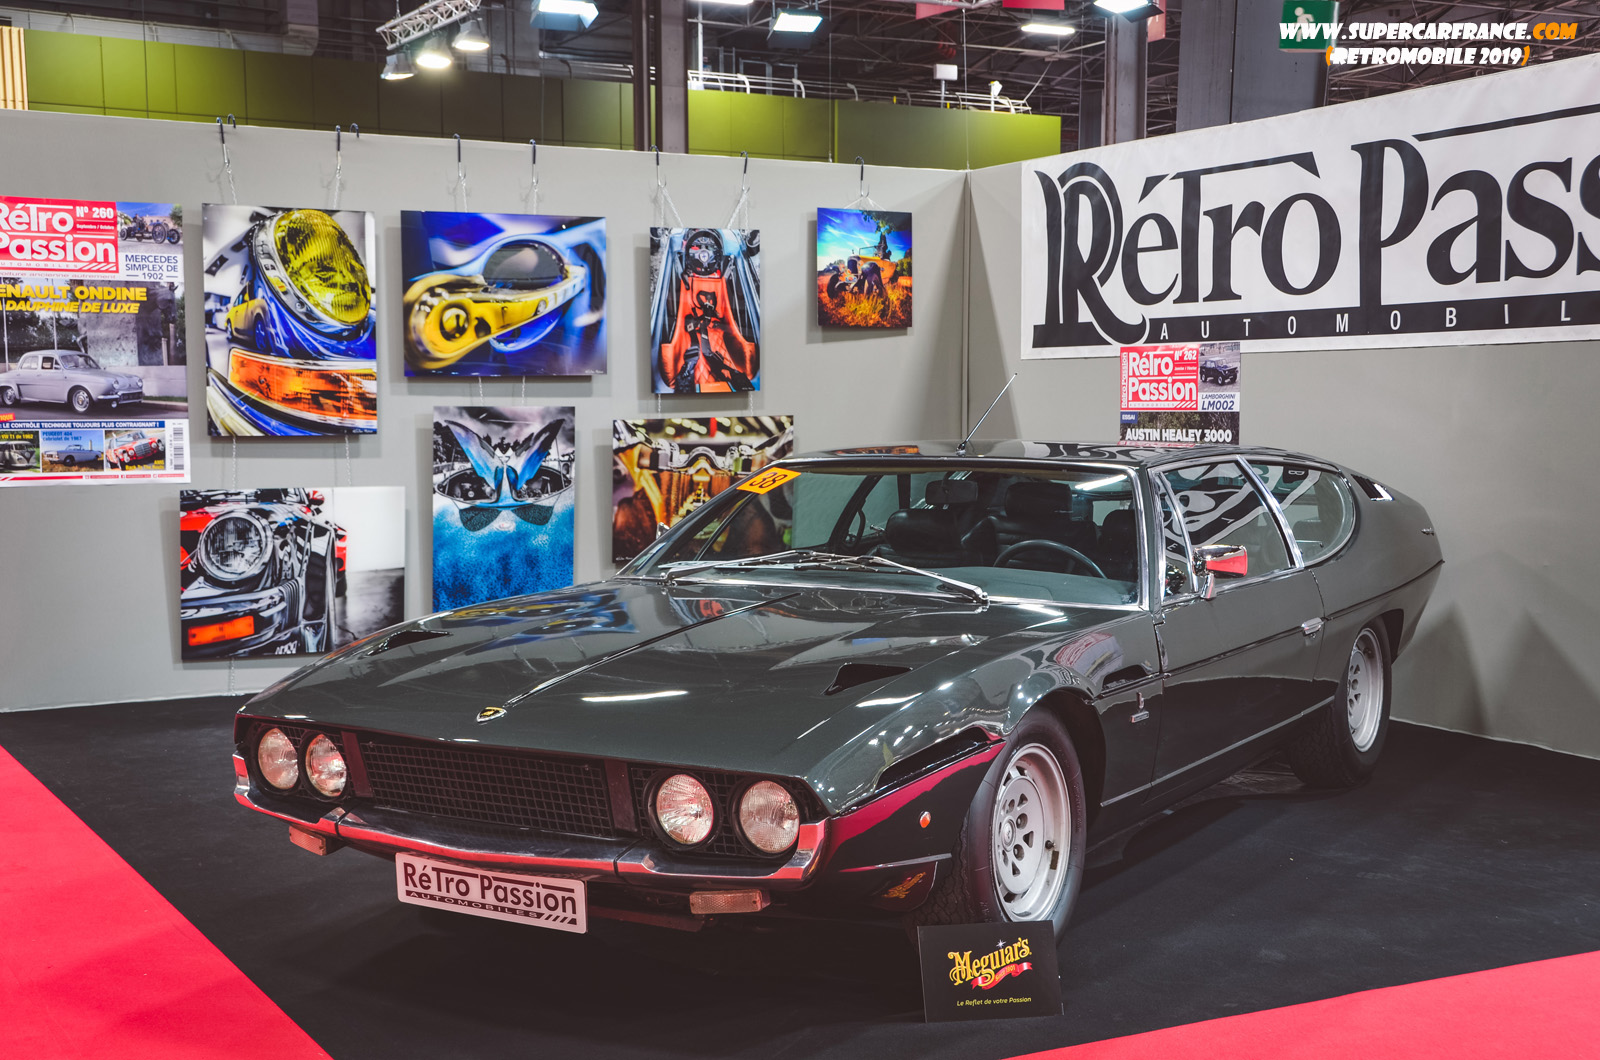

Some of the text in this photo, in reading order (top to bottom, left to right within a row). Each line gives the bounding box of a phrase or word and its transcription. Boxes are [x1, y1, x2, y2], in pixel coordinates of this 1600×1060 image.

[92, 207, 115, 219] 260
[125, 254, 178, 264] MERCEDES
[125, 263, 178, 273] SIMPLEX DE
[142, 272, 164, 280] 1902
[74, 285, 148, 301] ONDINE
[5, 300, 79, 313] DAUPHINE
[81, 302, 100, 313] DE
[102, 302, 140, 314] LUXE
[1184, 350, 1197, 361] 262
[1128, 376, 1197, 401] Passion
[1202, 400, 1235, 411] LM002
[11, 421, 40, 429] CONTRÔLE
[1125, 428, 1232, 443] AUSTIN HEALEY 3000
[748, 471, 788, 489] 38
[478, 874, 577, 915] Passion
[409, 891, 539, 919] AUTOMOBILES
[947, 937, 1031, 987] Meguiar's
[1005, 964, 1016, 974] 1901
[965, 999, 983, 1007] Reflet
[1009, 996, 1032, 1004] Passion
